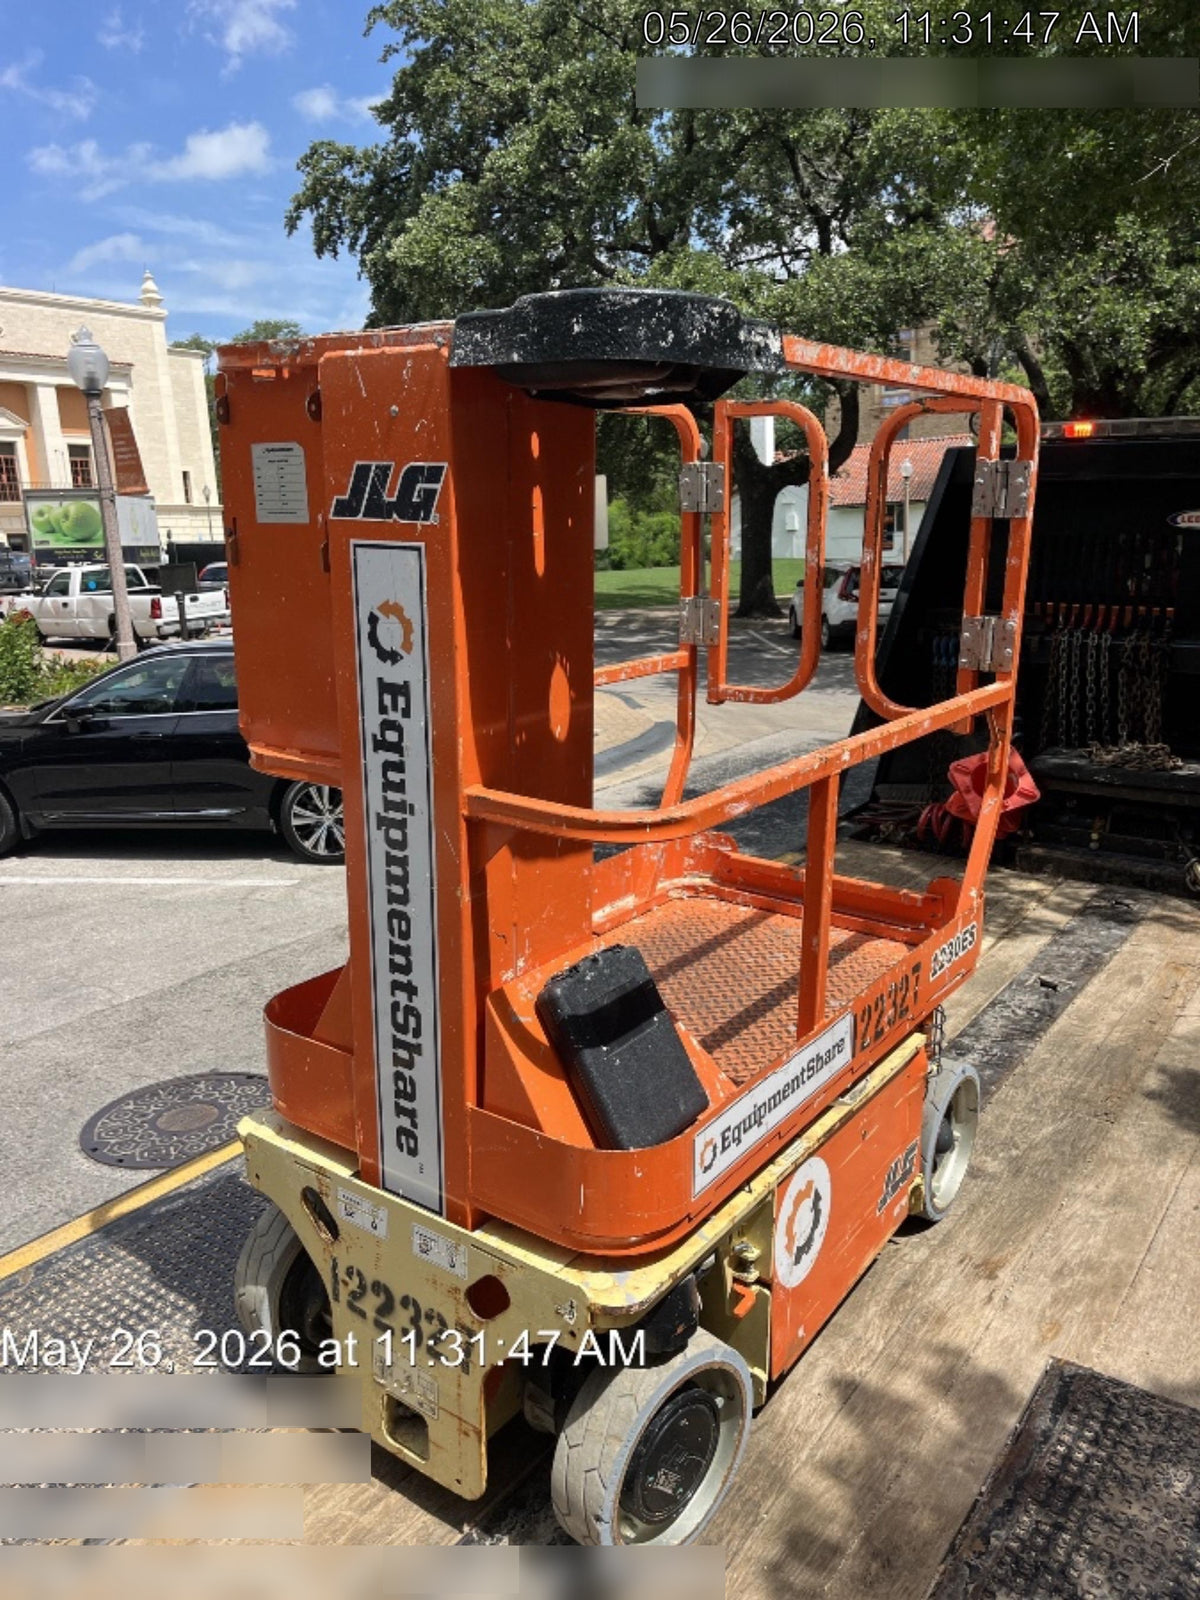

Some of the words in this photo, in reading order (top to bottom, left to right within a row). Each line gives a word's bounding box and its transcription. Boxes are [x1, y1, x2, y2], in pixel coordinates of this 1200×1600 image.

[329, 460, 449, 524] JLG
[371, 676, 423, 1159] EquipmentShare
[719, 1036, 846, 1154] EquipmentShare
